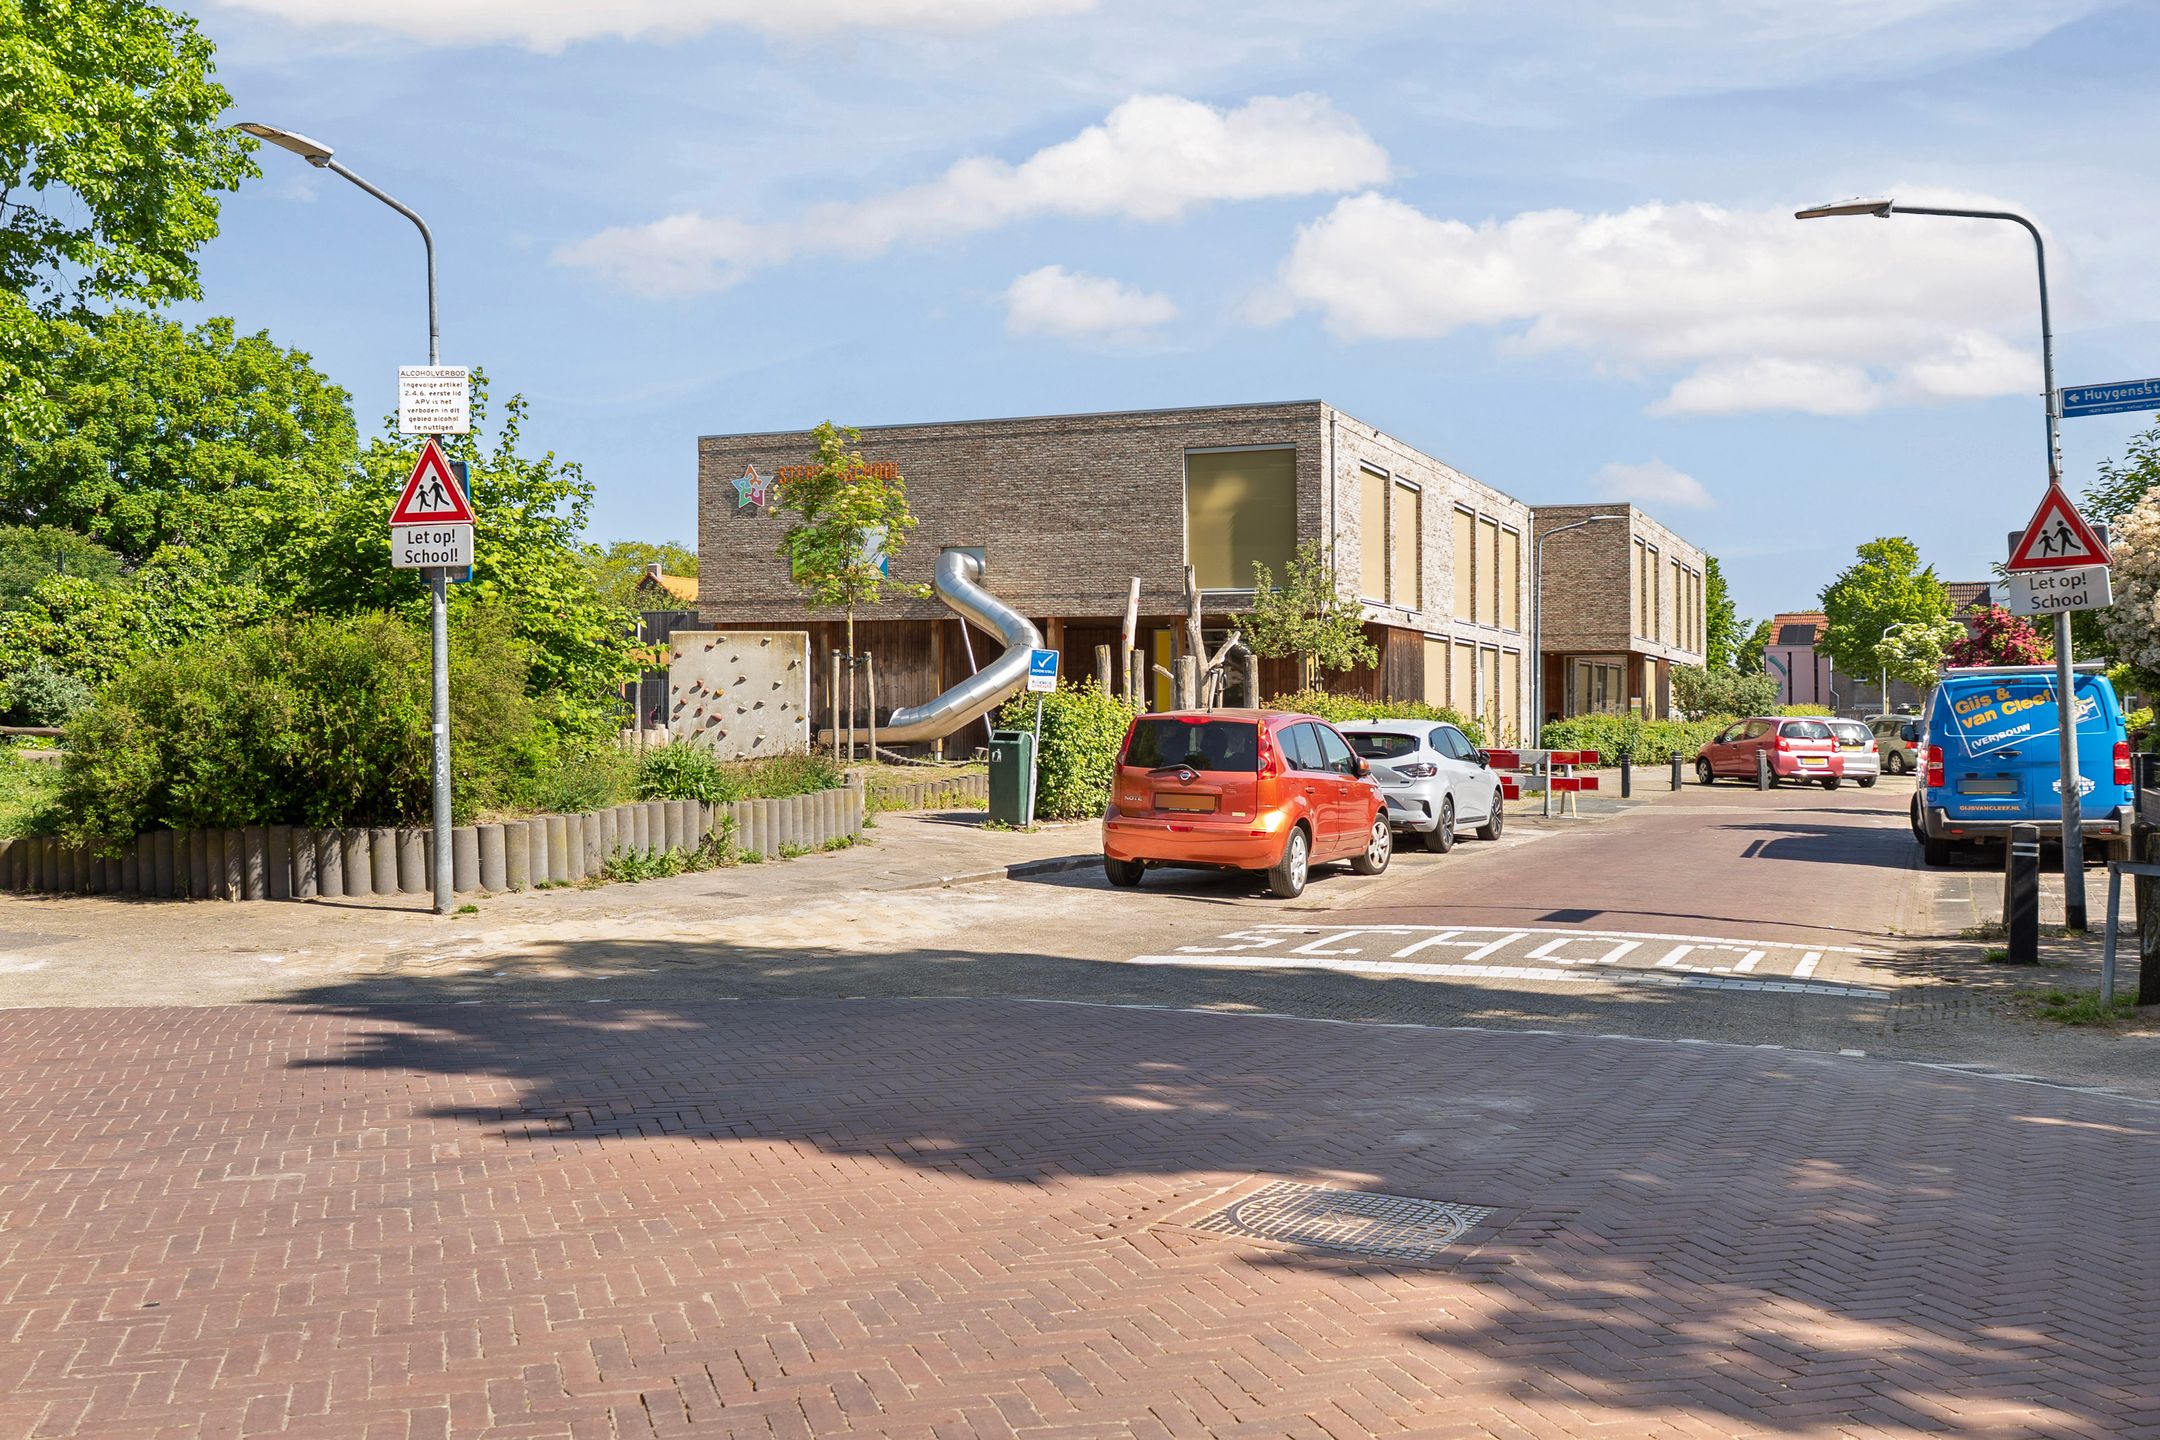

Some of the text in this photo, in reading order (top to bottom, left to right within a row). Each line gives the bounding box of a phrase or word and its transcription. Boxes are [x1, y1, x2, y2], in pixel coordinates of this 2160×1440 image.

[407, 529, 456, 547] Let op!
[404, 548, 459, 564] School!
[2029, 572, 2087, 591] Let op!
[2031, 591, 2088, 610] School
[1954, 687, 2012, 715] Gijs &
[1960, 708, 1998, 729] van
[2001, 689, 2052, 716] Cleef
[1970, 722, 2031, 750] (VER)BOUW
[1173, 928, 1851, 984] SCHOOL
